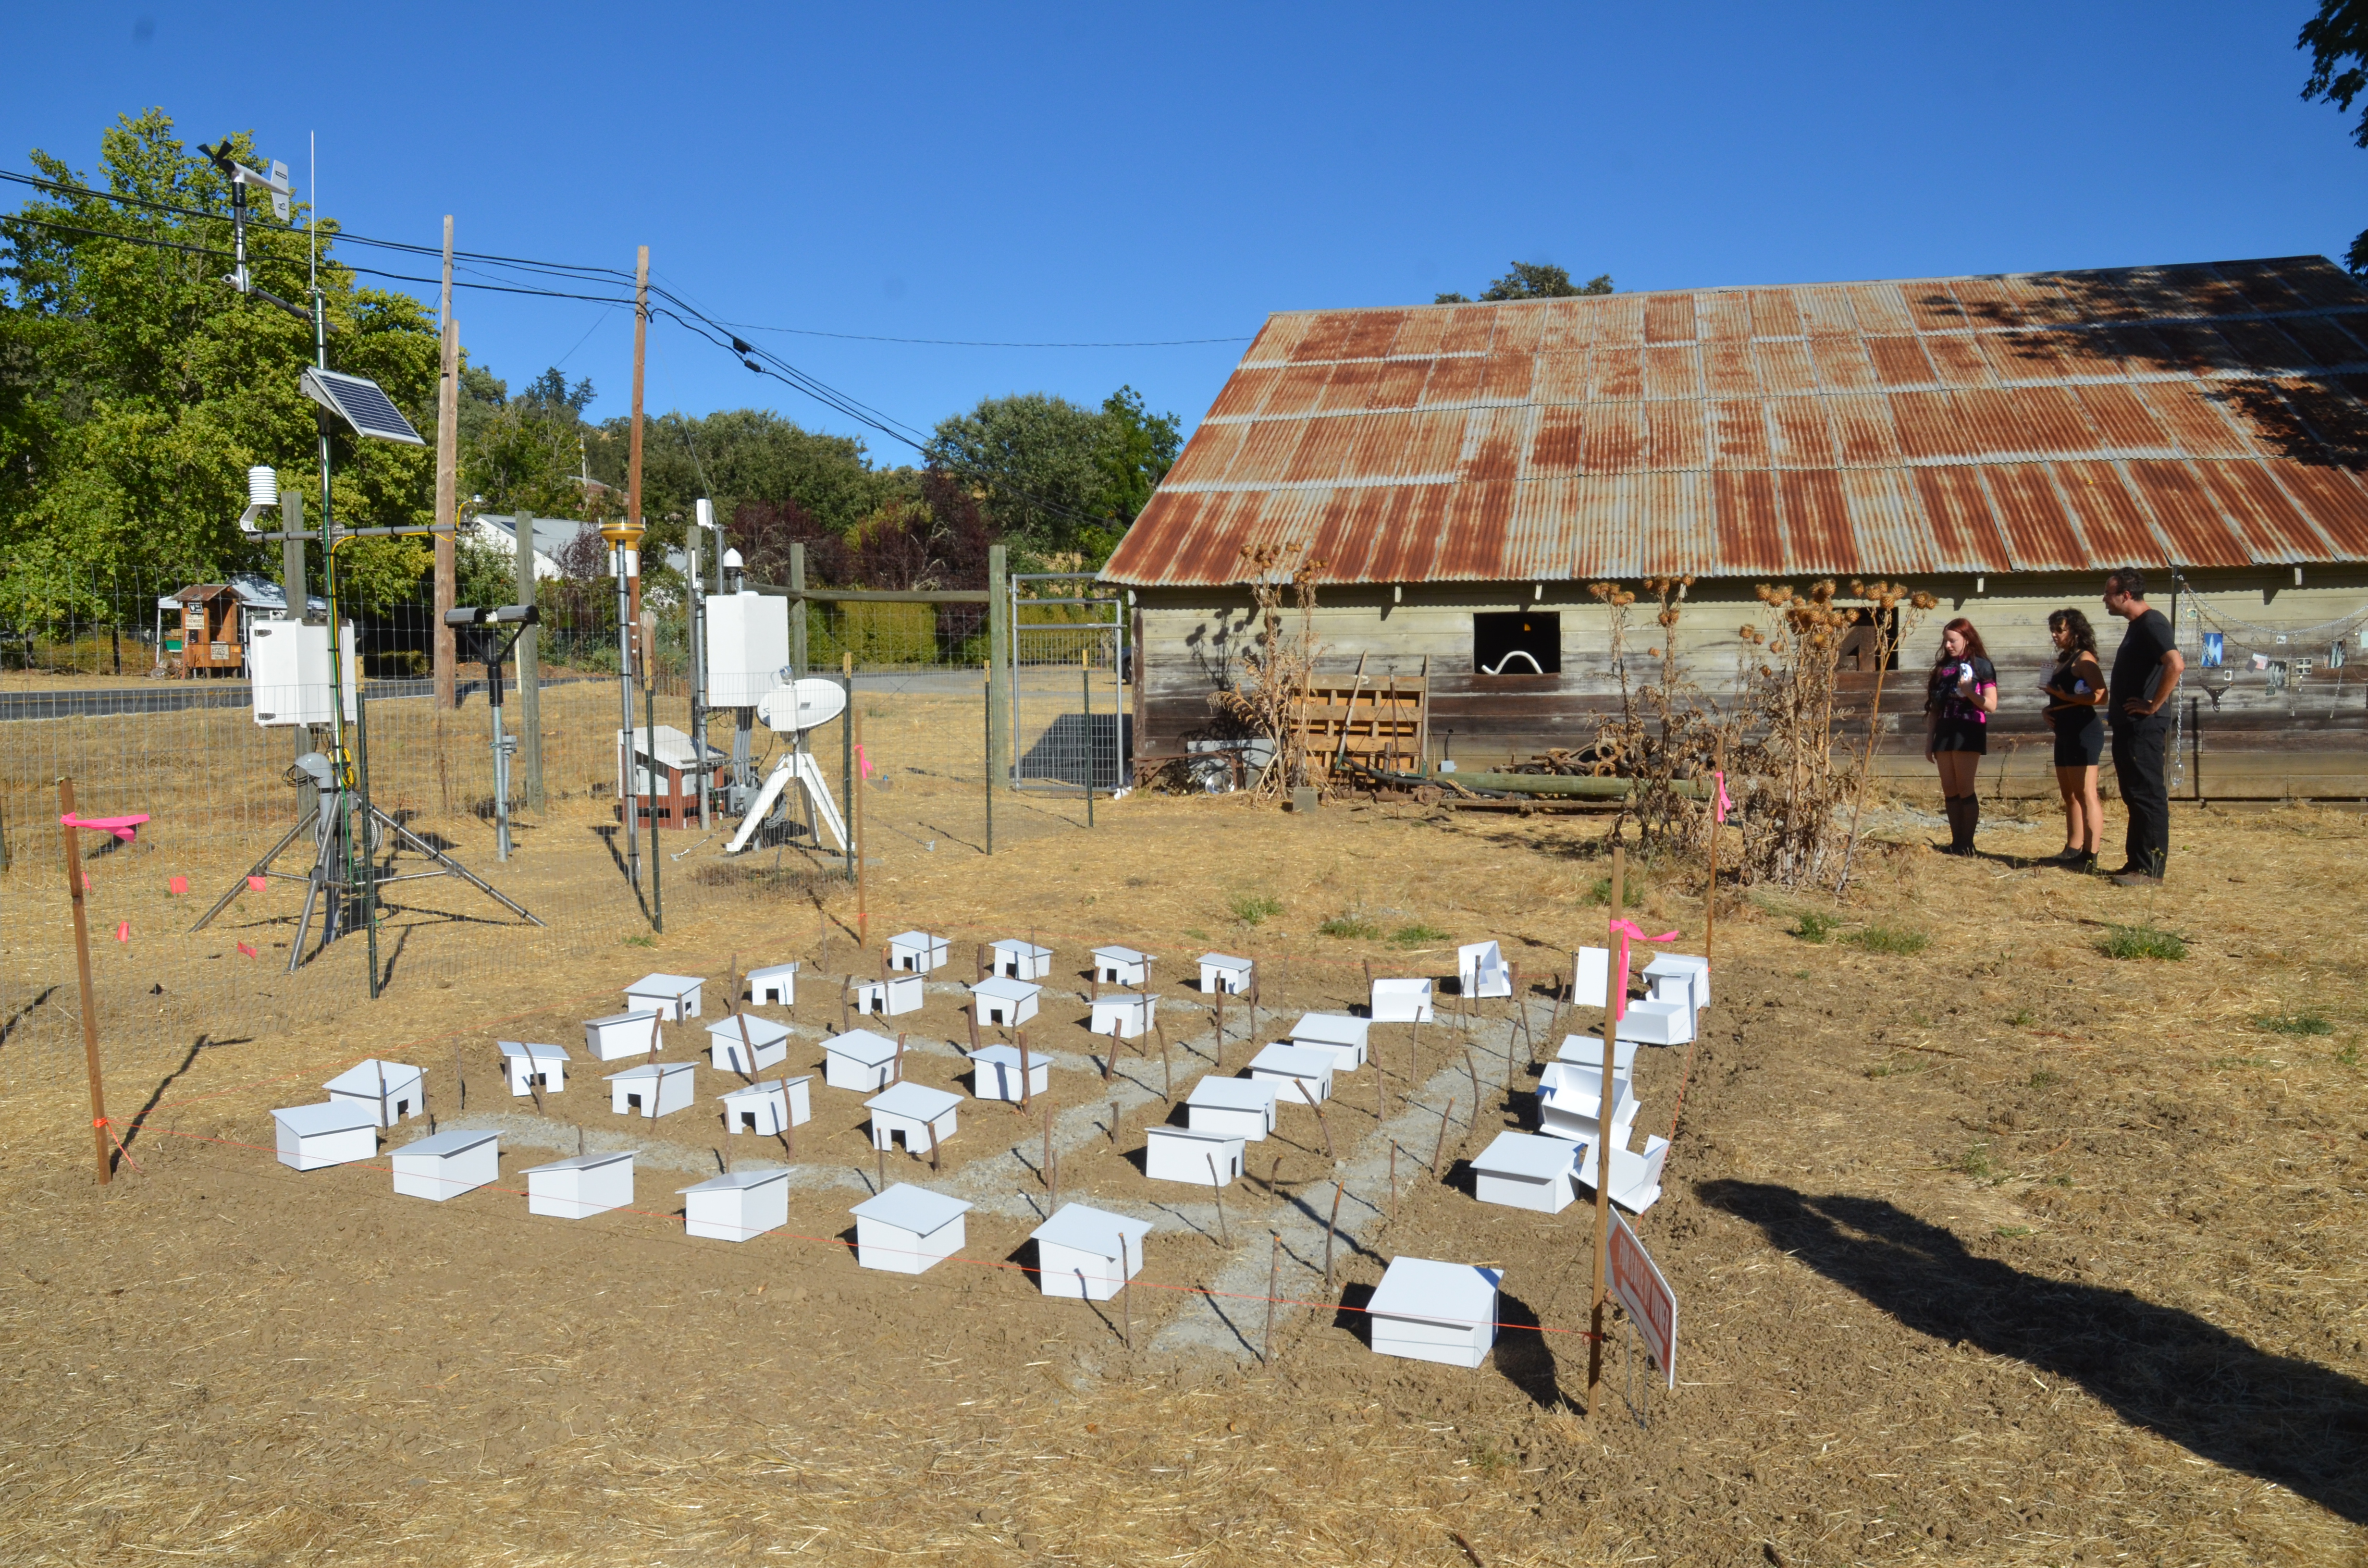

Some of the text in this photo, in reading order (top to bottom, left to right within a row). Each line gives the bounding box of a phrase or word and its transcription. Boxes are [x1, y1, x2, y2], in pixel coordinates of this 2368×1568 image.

[1619, 1234, 1669, 1345] FOR SALE BY OWNER
